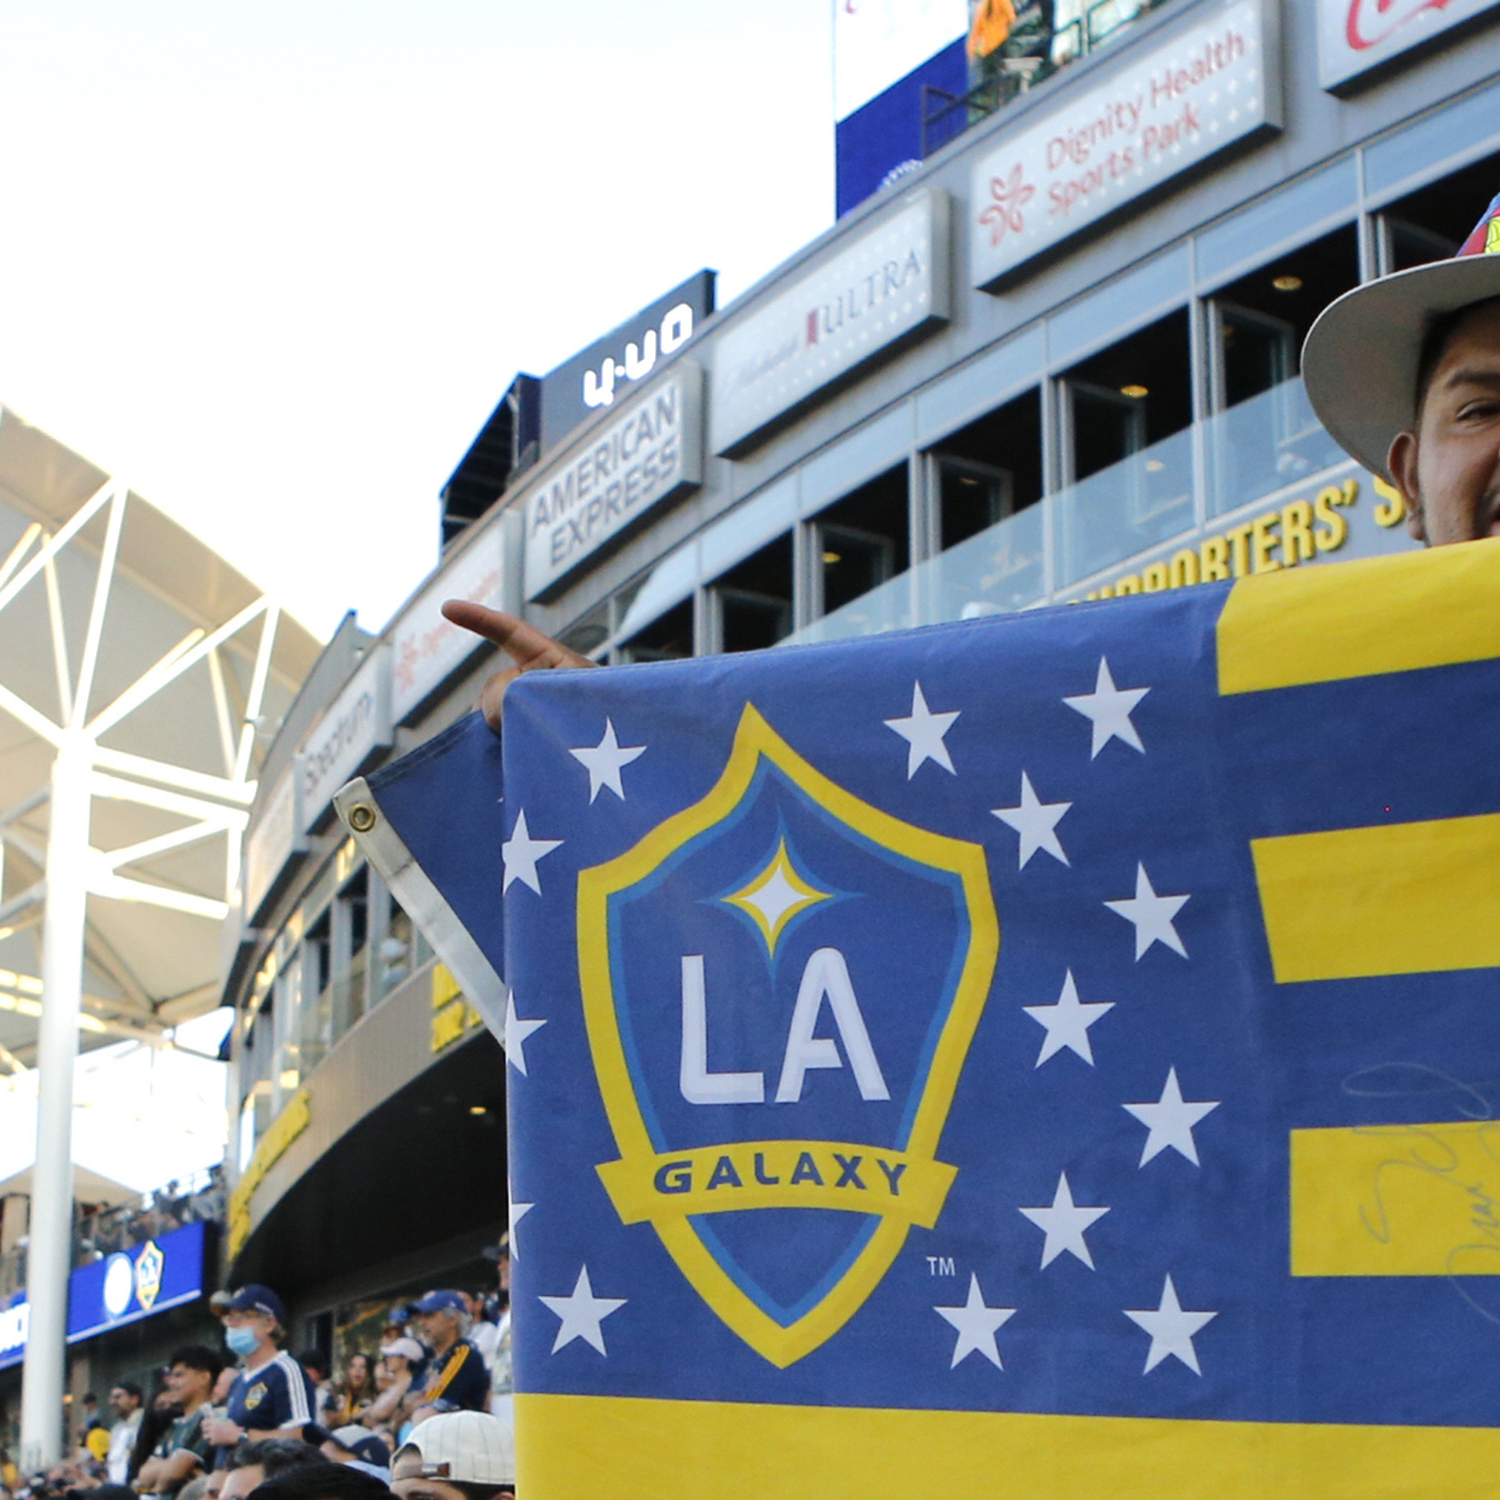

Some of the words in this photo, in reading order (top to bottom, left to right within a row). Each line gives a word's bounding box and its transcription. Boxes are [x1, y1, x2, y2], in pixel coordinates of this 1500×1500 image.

[1047, 96, 1143, 170] Dignity
[1150, 30, 1246, 107] Health
[1048, 147, 1134, 216] Sports
[1143, 103, 1201, 159] Park
[821, 248, 922, 334] ULTRA
[530, 385, 678, 540] AMERICAN
[550, 433, 679, 568] EXPRESS
[680, 946, 892, 1106] LA
[653, 1151, 908, 1197] GALAXY
[926, 1256, 956, 1277] TM
